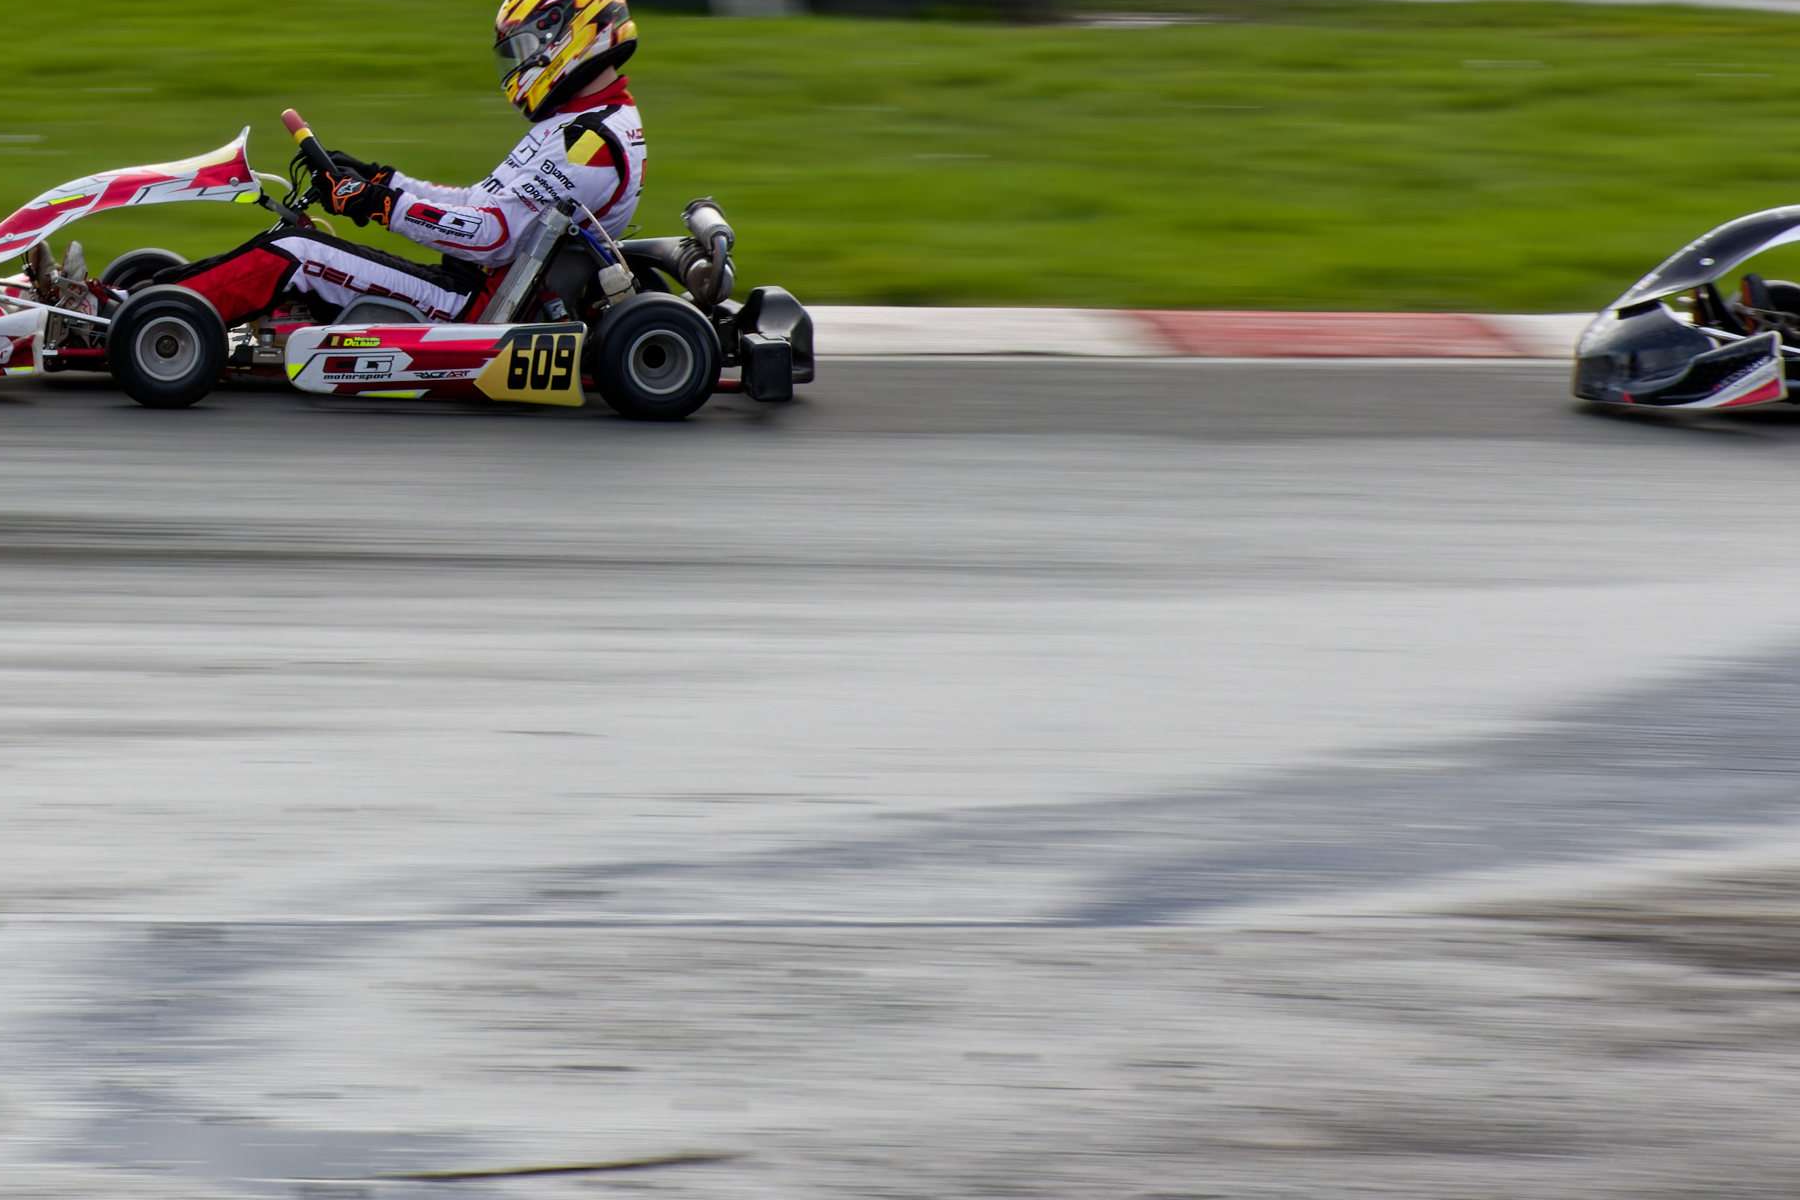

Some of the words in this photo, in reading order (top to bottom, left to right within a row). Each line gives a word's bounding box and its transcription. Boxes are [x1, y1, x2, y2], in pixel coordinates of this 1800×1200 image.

[406, 202, 483, 234] CG
[323, 355, 394, 373] CG
[507, 335, 576, 390] 609
[323, 373, 393, 381] motorsport
